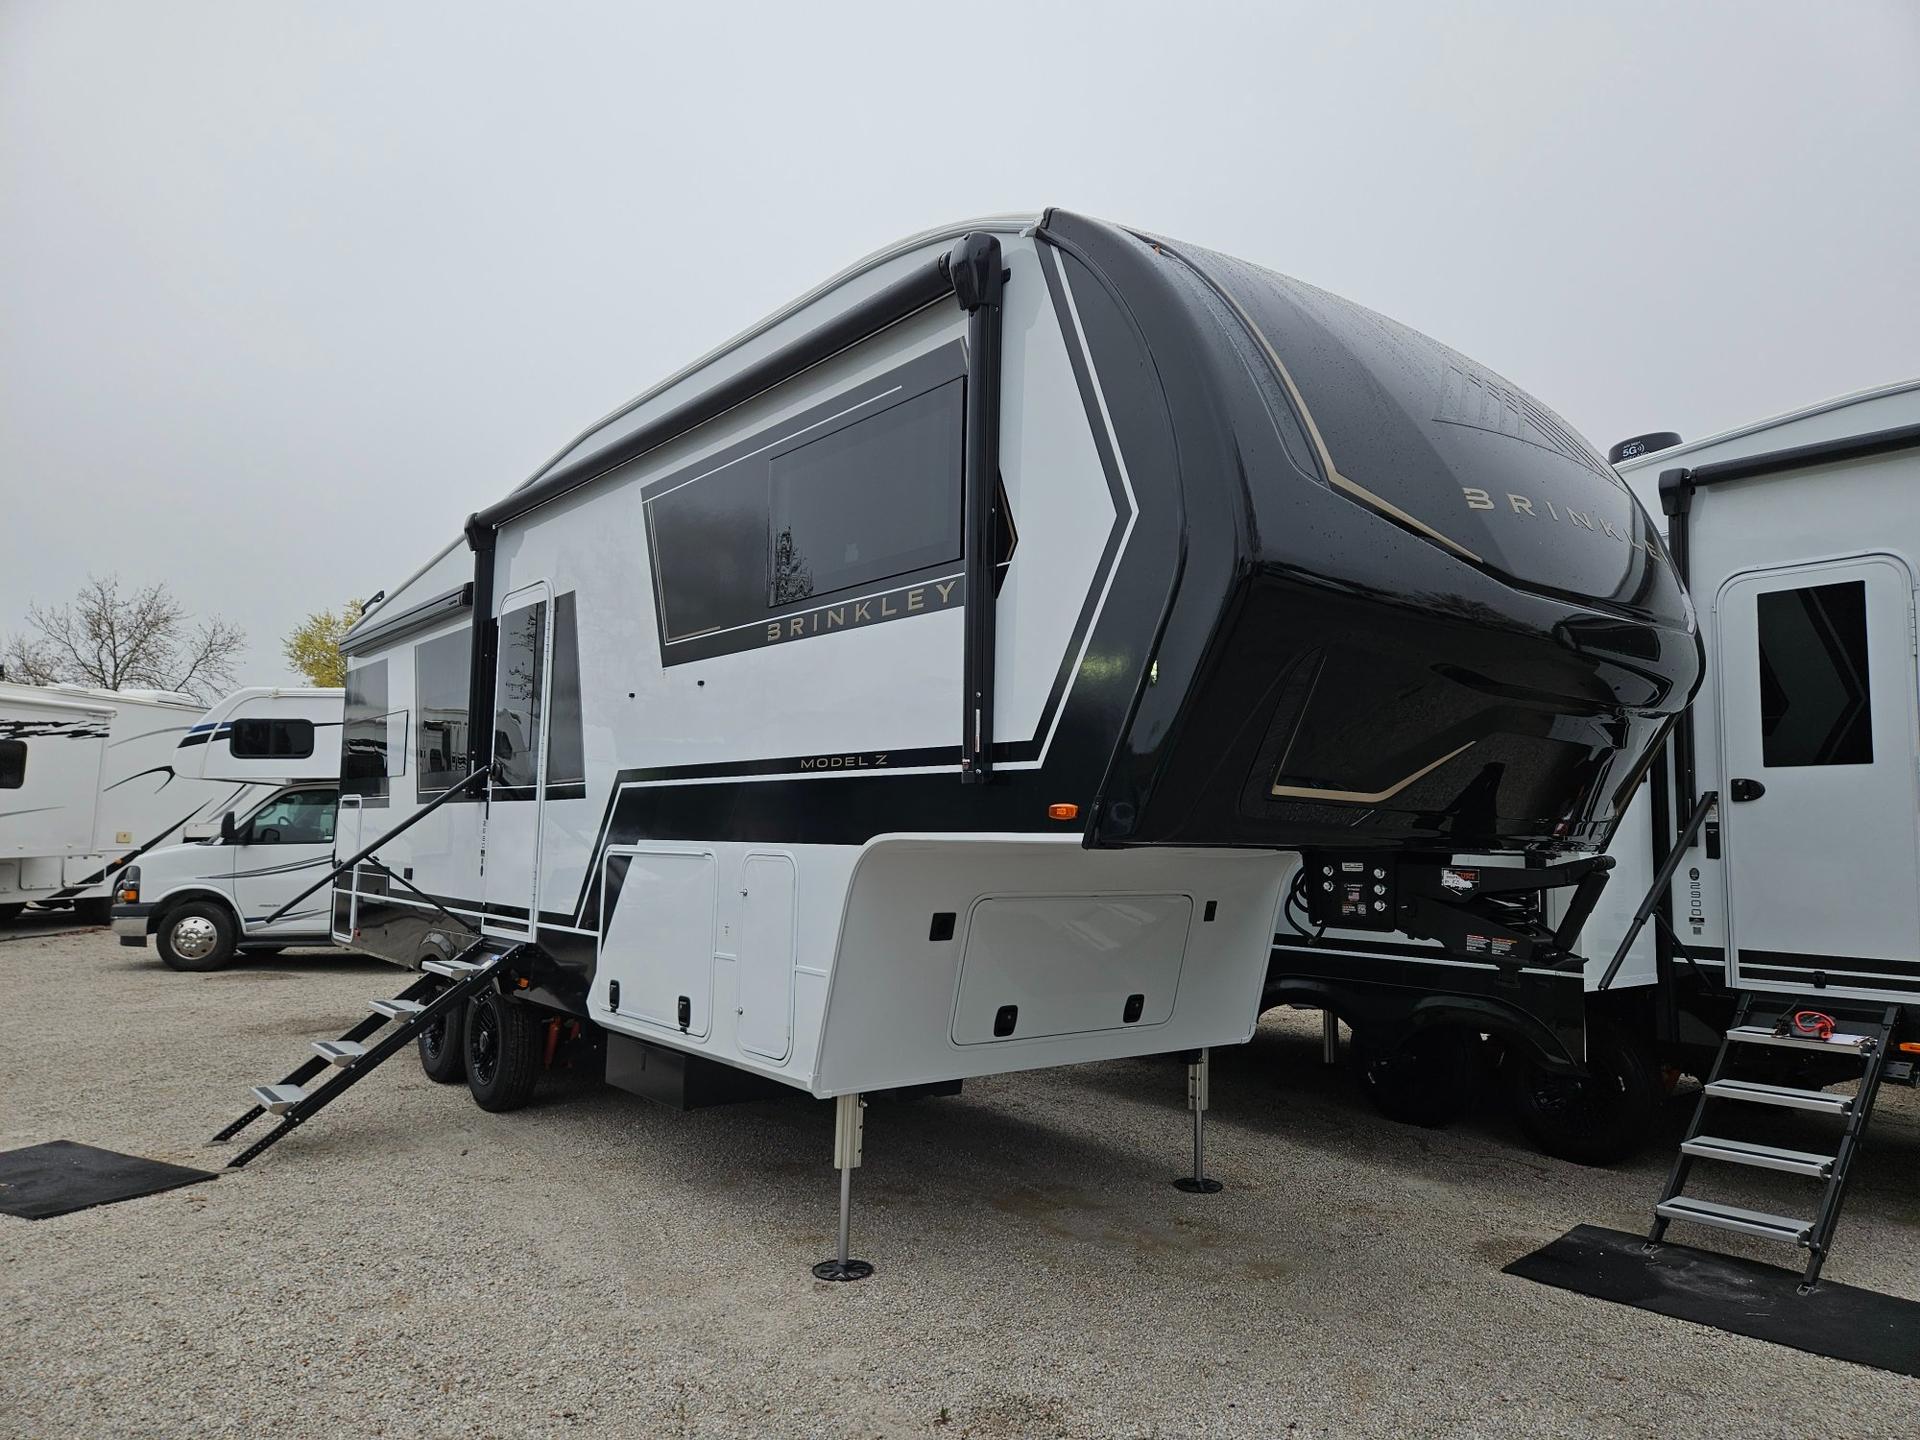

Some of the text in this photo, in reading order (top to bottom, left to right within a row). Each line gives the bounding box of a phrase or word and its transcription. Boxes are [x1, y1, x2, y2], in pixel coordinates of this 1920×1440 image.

[1622, 446, 1638, 457] 5G
[1462, 487, 1664, 561] BRINKLE
[768, 581, 958, 641] BRINKLEY
[800, 754, 888, 769] MODEL Z
